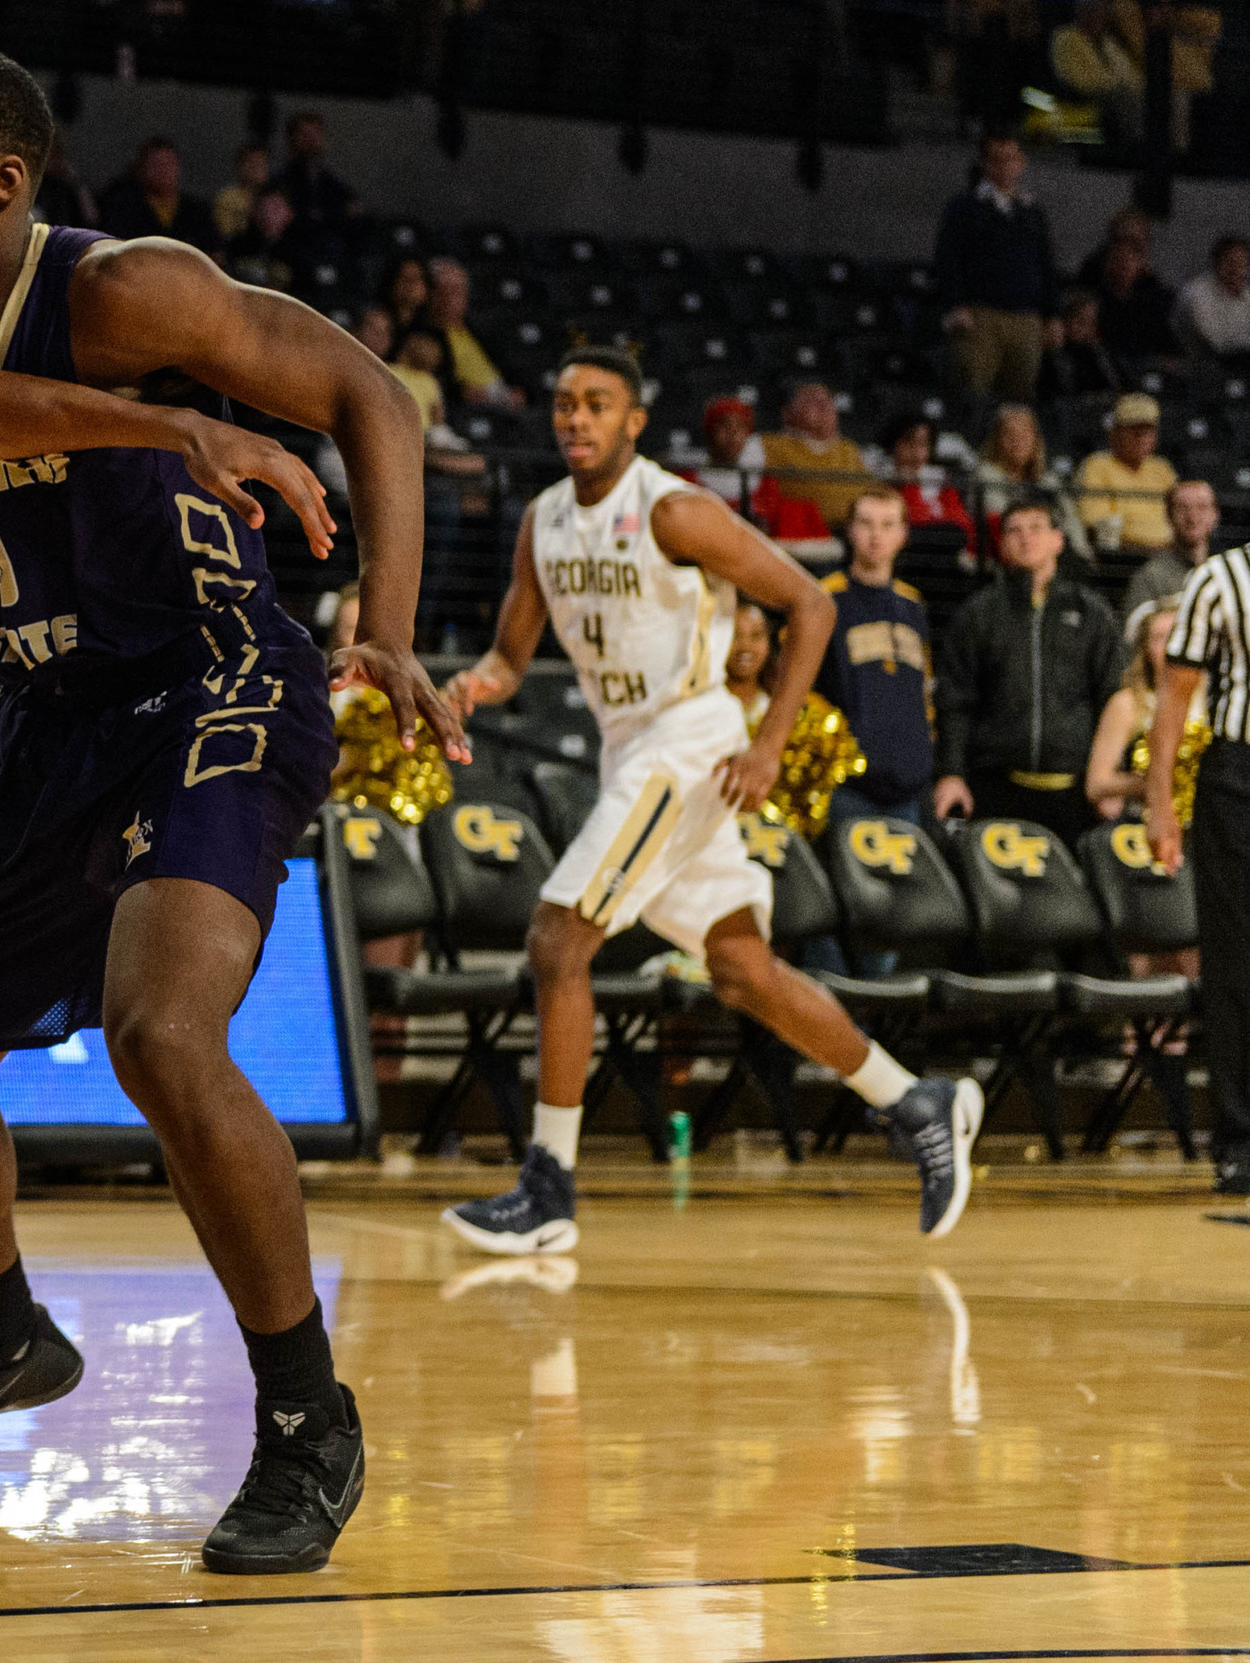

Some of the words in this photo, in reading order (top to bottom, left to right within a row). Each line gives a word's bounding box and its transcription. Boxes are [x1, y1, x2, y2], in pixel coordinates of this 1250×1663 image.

[546, 557, 642, 599] EOGIA
[583, 612, 606, 662] 4
[344, 815, 382, 860] T
[455, 805, 523, 862] GT
[851, 820, 917, 875] GT
[982, 822, 1050, 877] GT
[1111, 823, 1169, 877] G
